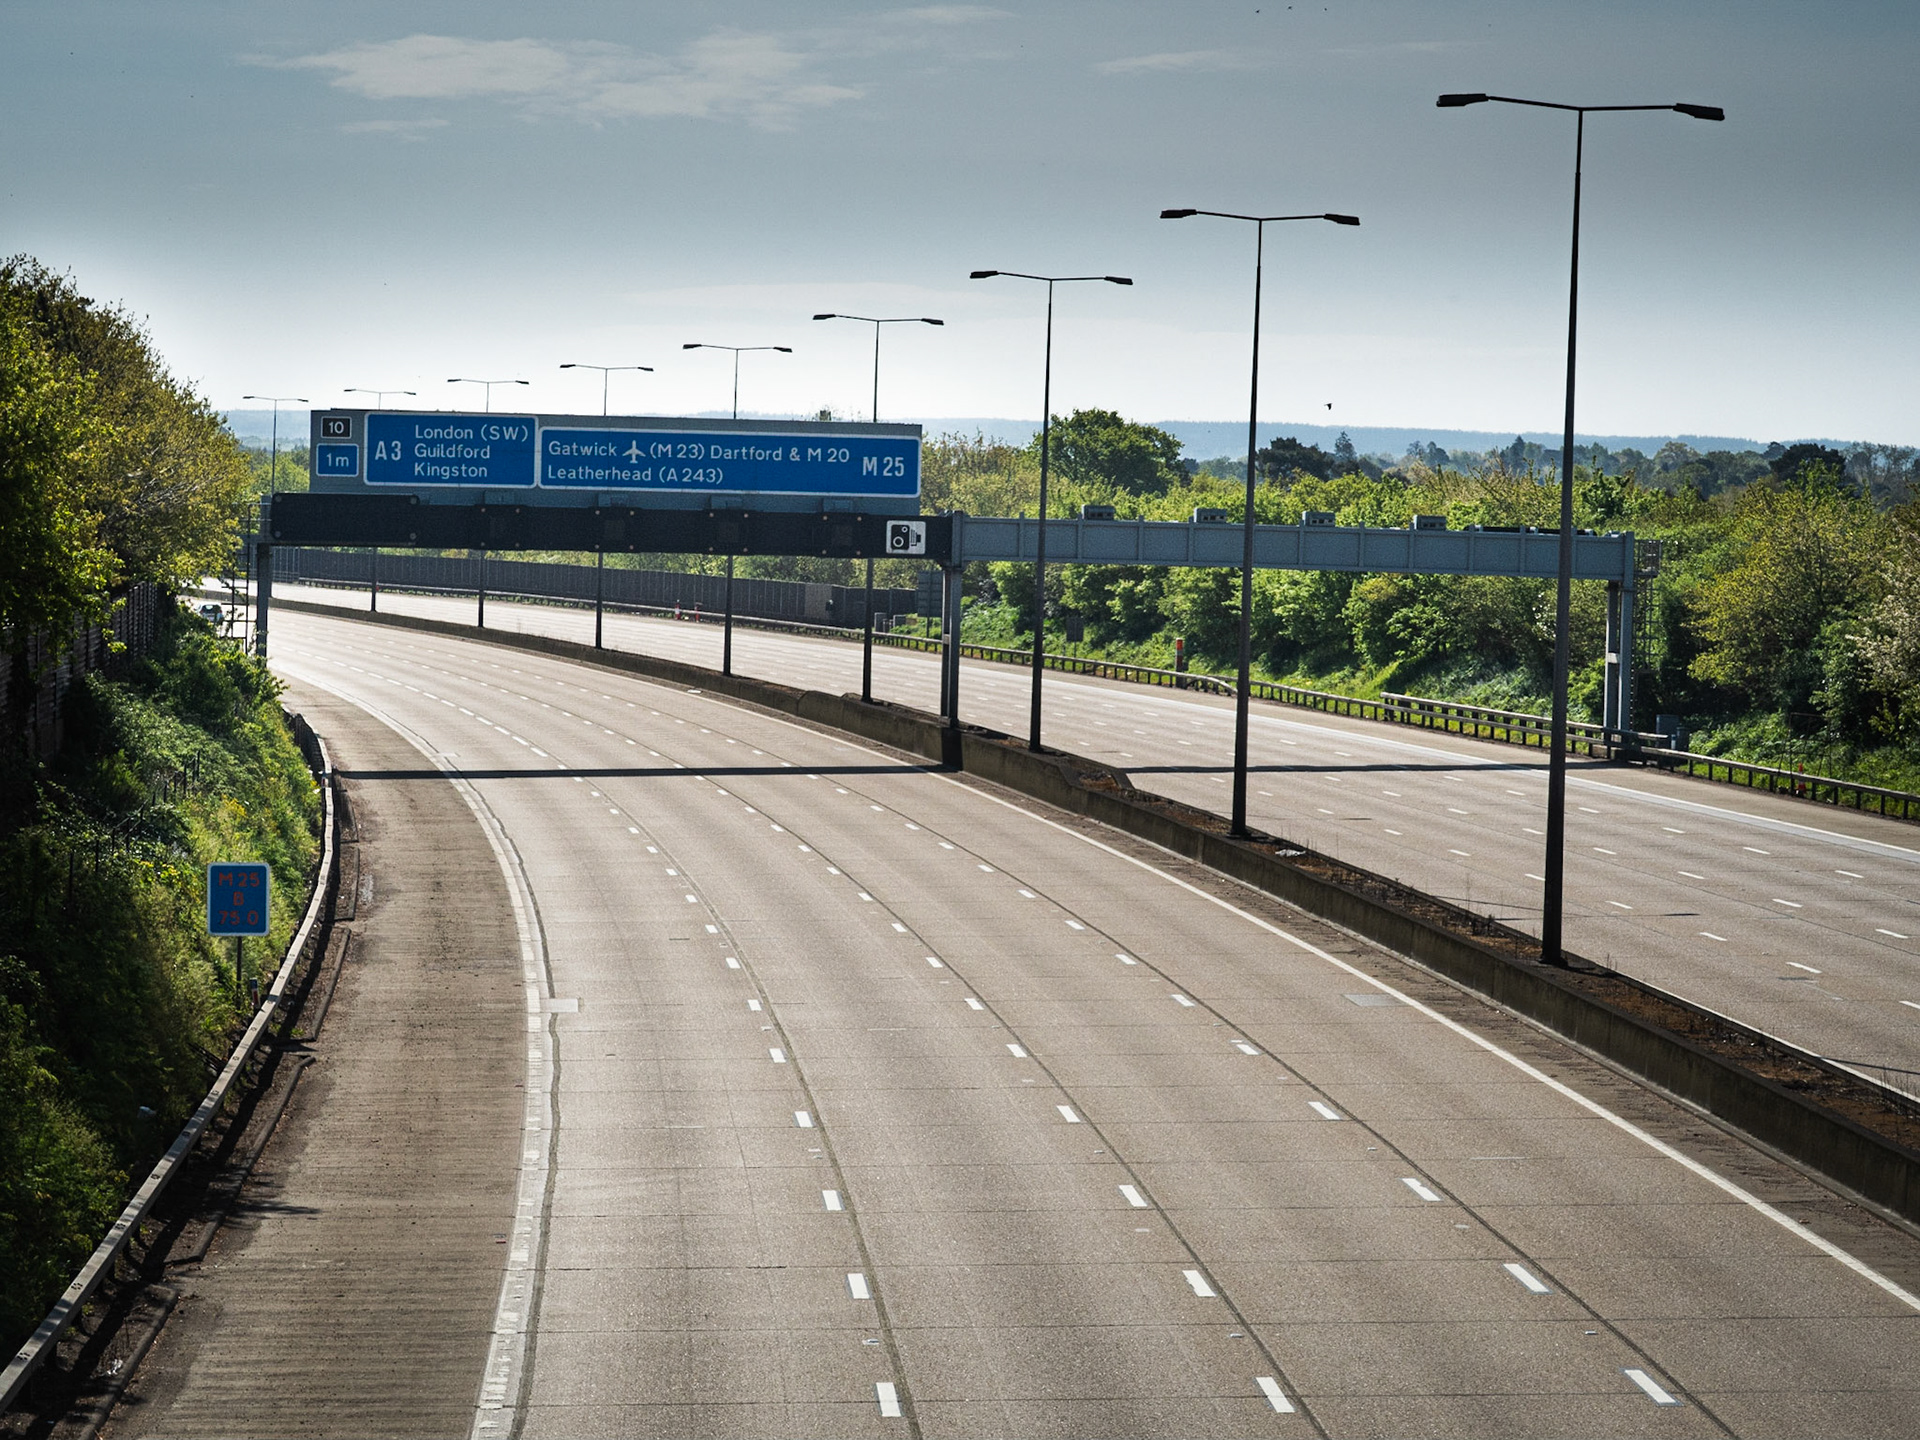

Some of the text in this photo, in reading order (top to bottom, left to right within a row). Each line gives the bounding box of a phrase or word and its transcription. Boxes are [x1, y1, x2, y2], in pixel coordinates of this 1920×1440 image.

[328, 421, 345, 434] 10
[414, 423, 529, 442] London (SW)
[414, 443, 491, 459] Guildford
[548, 440, 617, 457] Gatwick
[710, 444, 783, 461] Dartford
[789, 446, 801, 462] &
[414, 462, 488, 480] Kingston
[547, 464, 652, 482] Leatherhead
